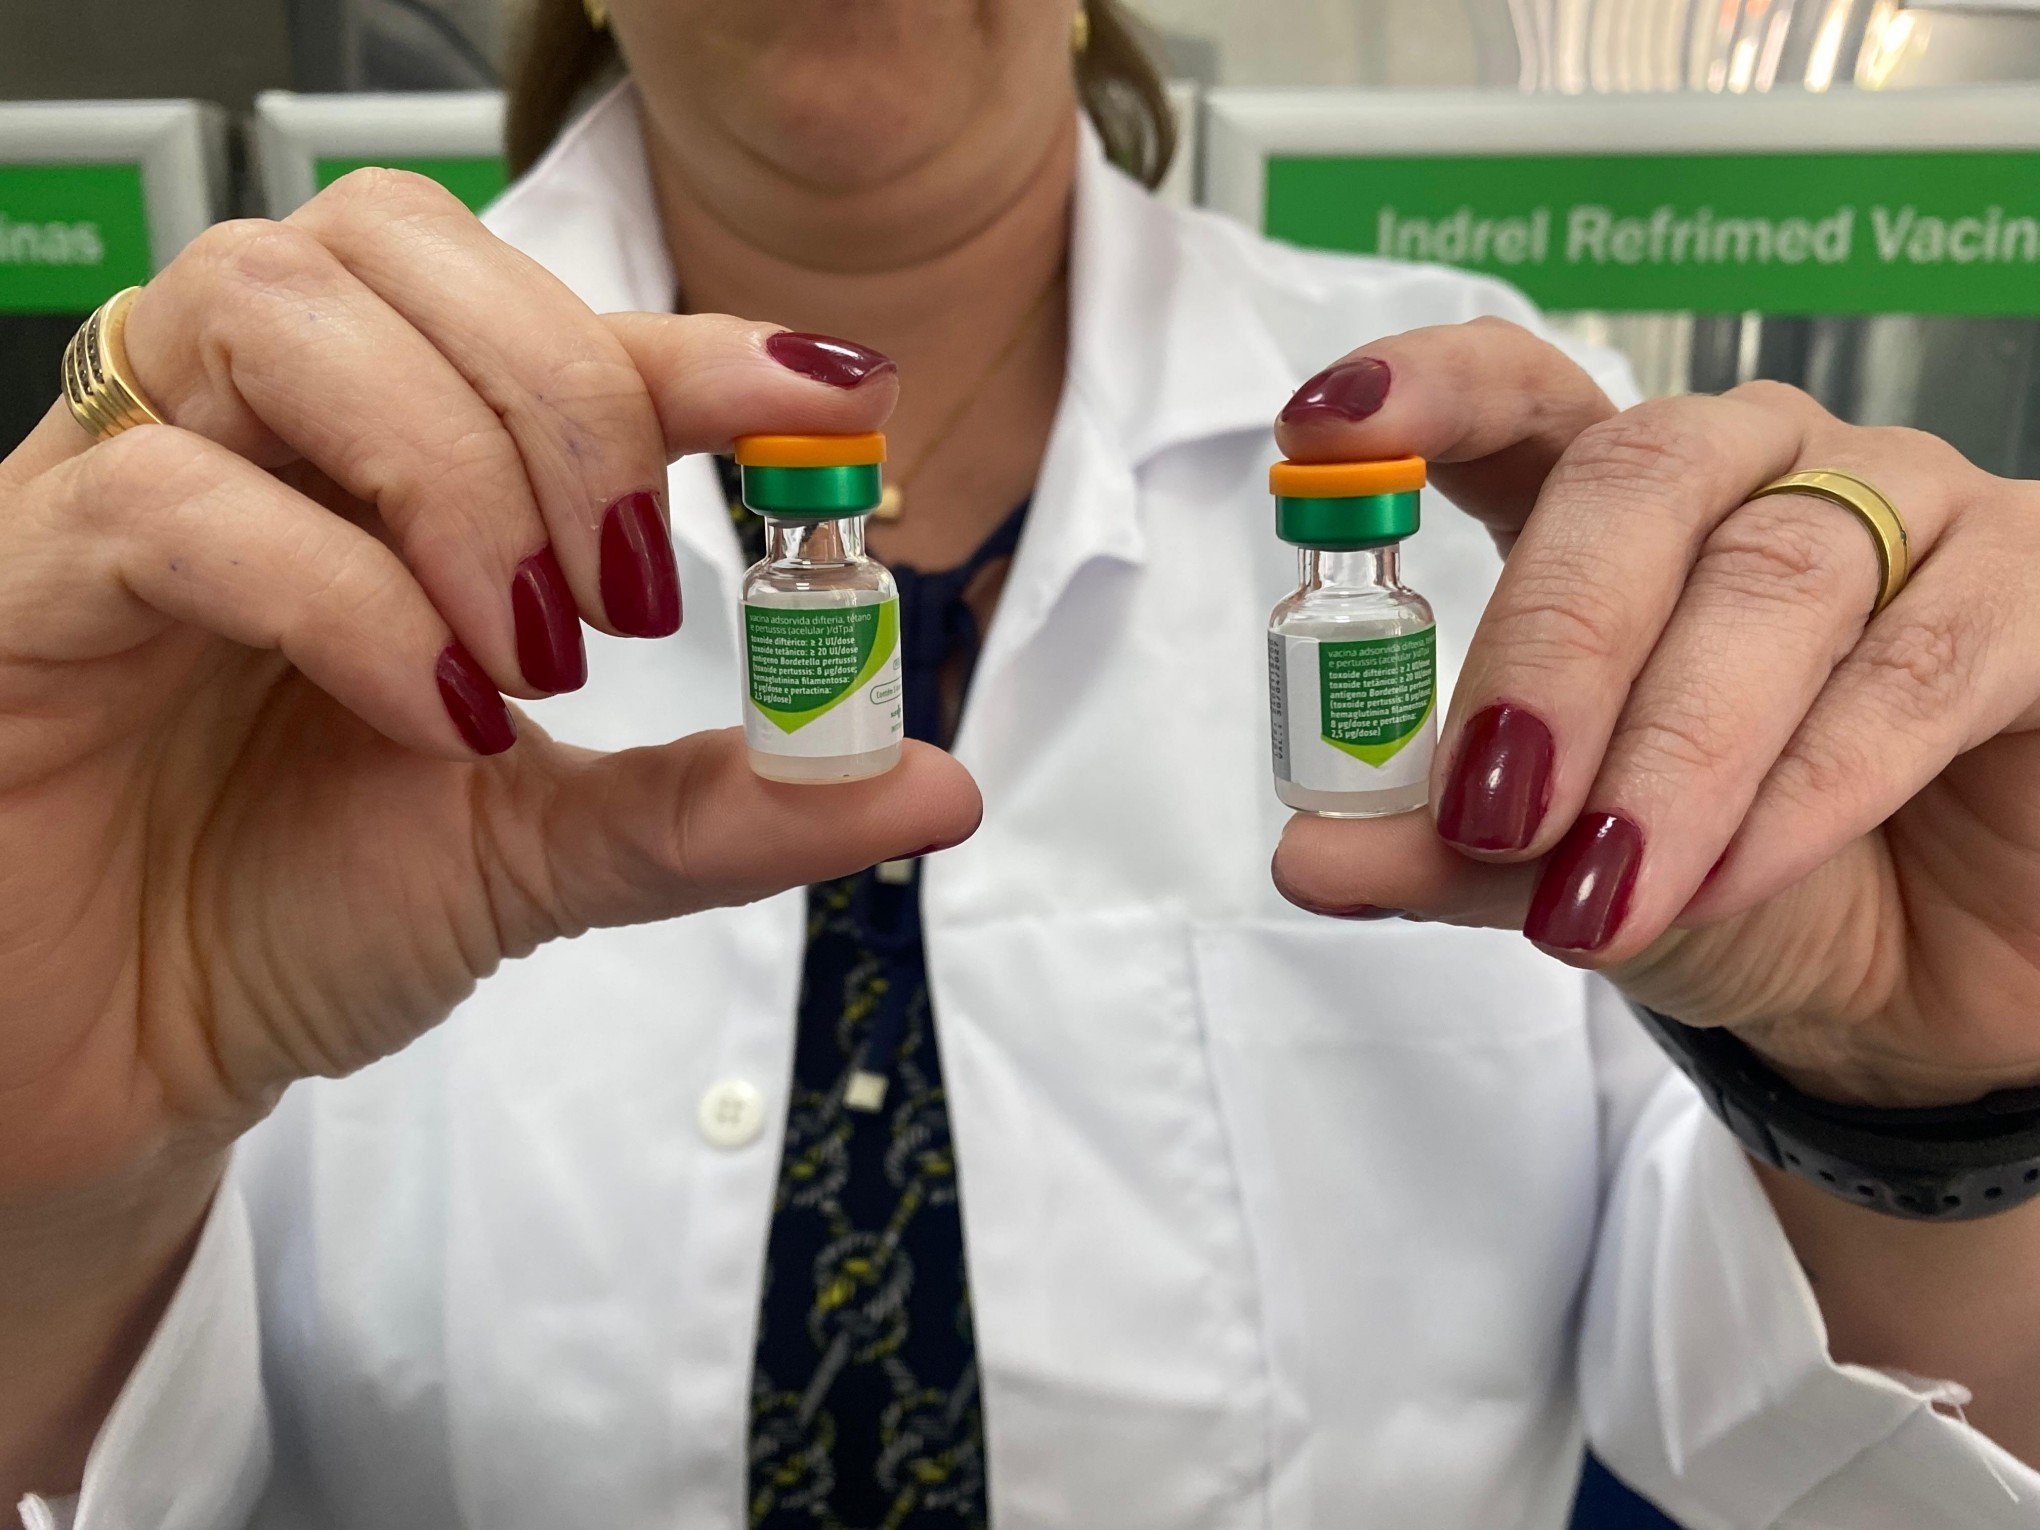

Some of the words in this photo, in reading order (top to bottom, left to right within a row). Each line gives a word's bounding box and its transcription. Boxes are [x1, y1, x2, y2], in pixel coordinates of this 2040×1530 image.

[1378, 206, 1549, 263] Indrel
[1567, 206, 1854, 264] Refrimed
[818, 638, 823, 646] 2
[817, 647, 827, 656] 20
[1328, 660, 1335, 668] e
[816, 667, 822, 676] 8
[1329, 670, 1360, 679] toxoide
[1329, 680, 1360, 689] toxoide
[1330, 719, 1336, 728] 8
[1372, 719, 1378, 727] e
